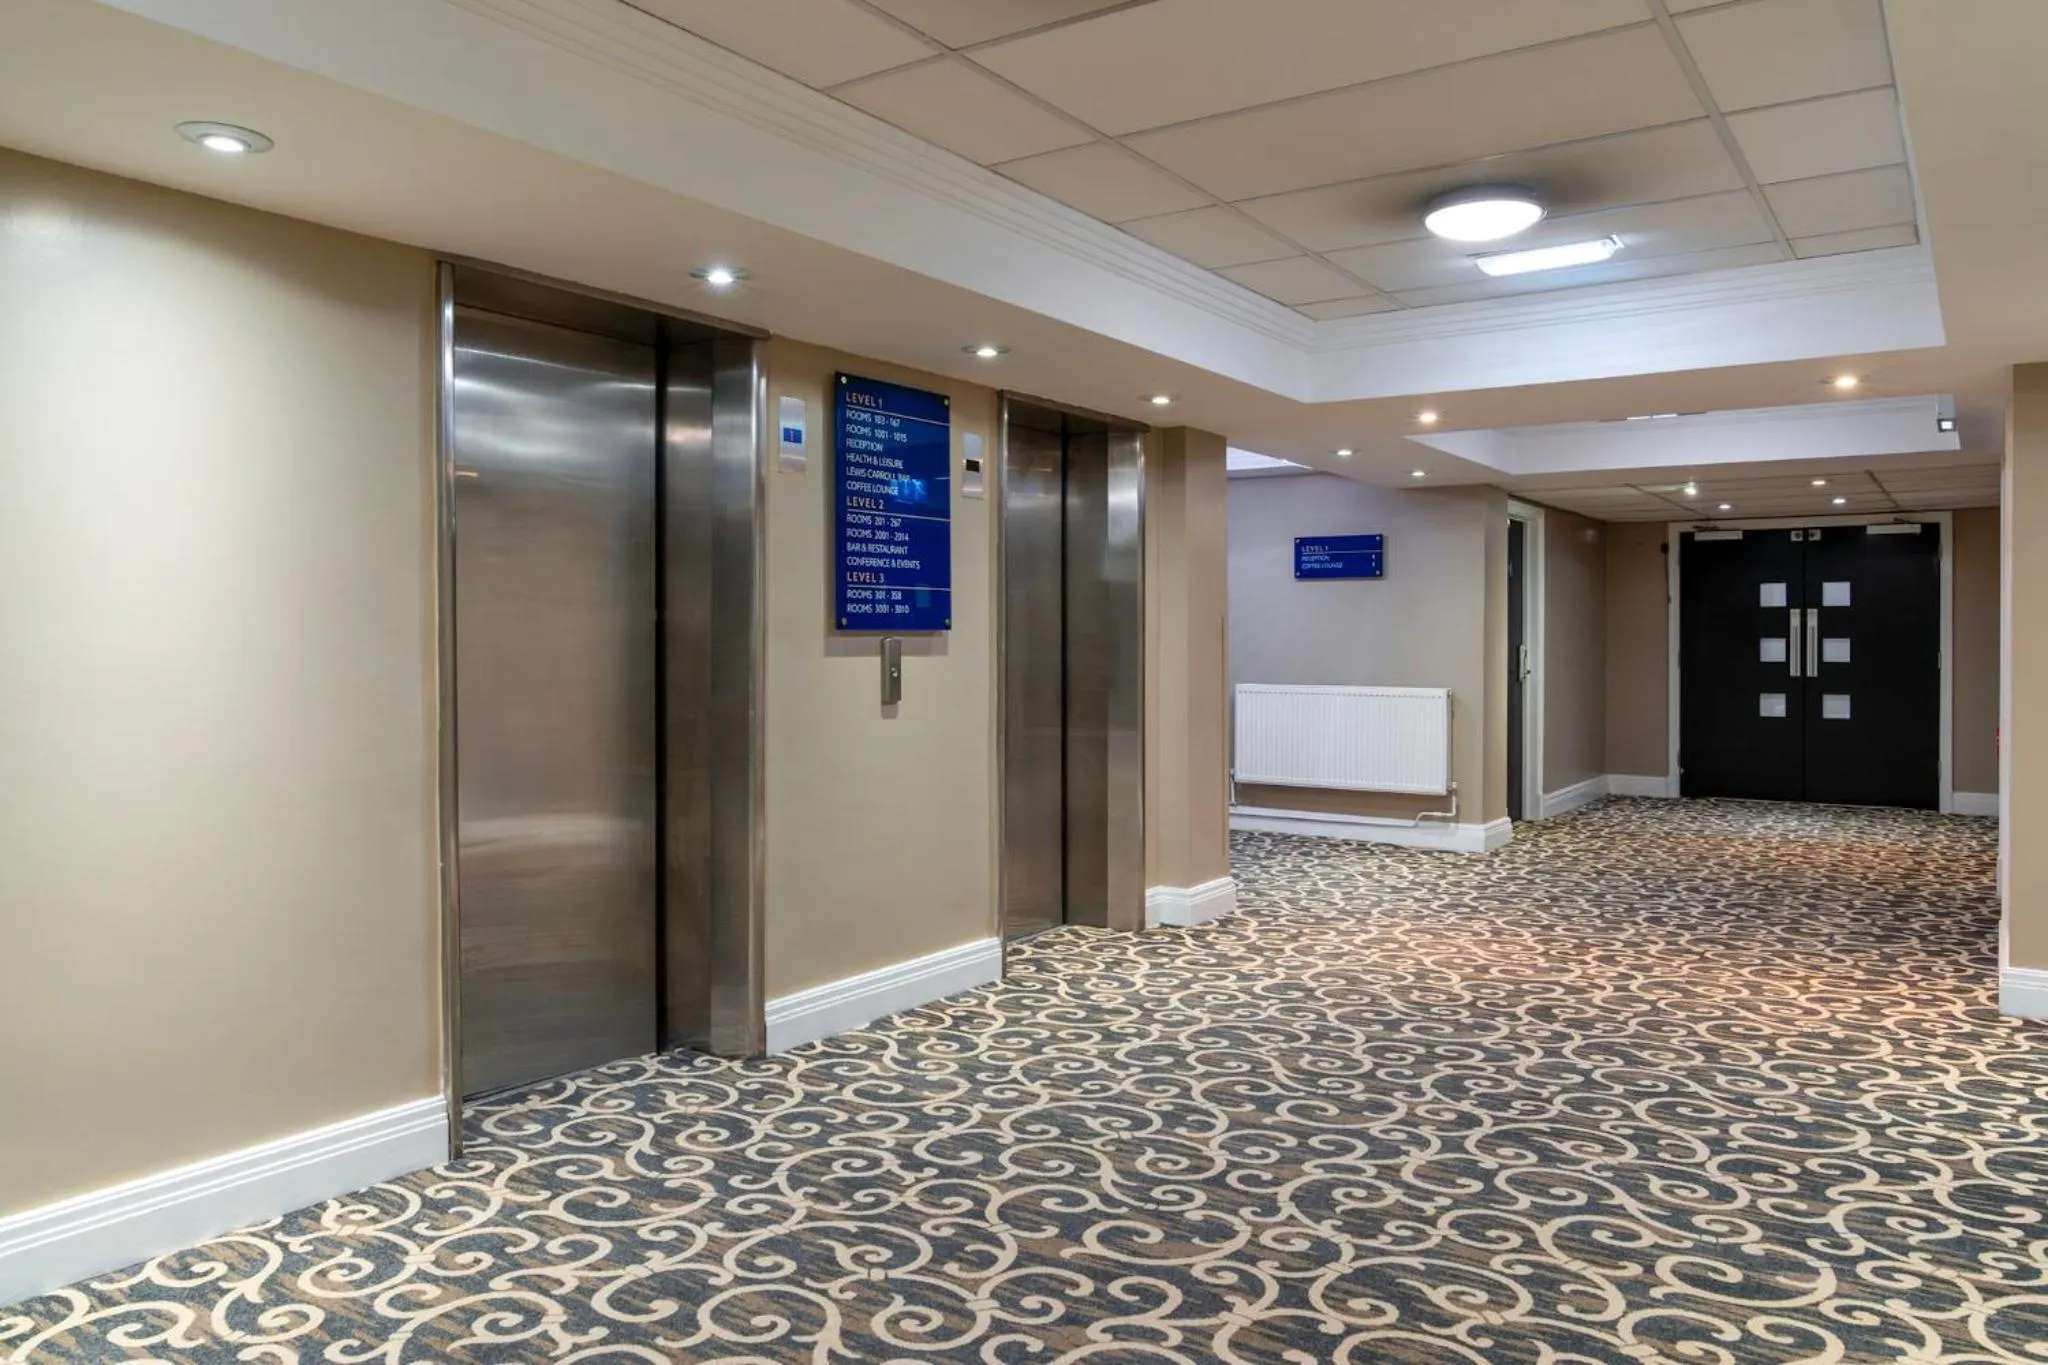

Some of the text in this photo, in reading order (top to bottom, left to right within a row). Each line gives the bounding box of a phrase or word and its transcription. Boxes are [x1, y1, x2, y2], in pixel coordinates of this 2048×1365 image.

[846, 392, 883, 408] LEVEL 1
[846, 409, 871, 422] ROOMS
[846, 424, 871, 436] ROOMS
[846, 438, 883, 452] RECEPTION
[846, 452, 872, 464] HEALTH
[879, 457, 904, 469] LEISURE
[846, 466, 866, 478] LEWIS
[868, 469, 896, 480] CARROLL
[846, 480, 899, 496] COFFEE LOUNGE
[846, 496, 884, 510] LEVEL 2
[846, 514, 872, 525] ROOMS
[874, 516, 886, 526] 201
[846, 528, 872, 538] ROOMS
[874, 530, 889, 540] 2001
[894, 532, 908, 542] 2014
[846, 542, 860, 553] BAR
[868, 544, 908, 555] RESTAURANT
[846, 556, 890, 568] CONFERENCE
[896, 559, 920, 570] EVENTS
[846, 572, 884, 584] LEVEL 3
[846, 590, 872, 600] ROOMS
[875, 590, 886, 600] 301
[846, 604, 872, 614] ROOMS
